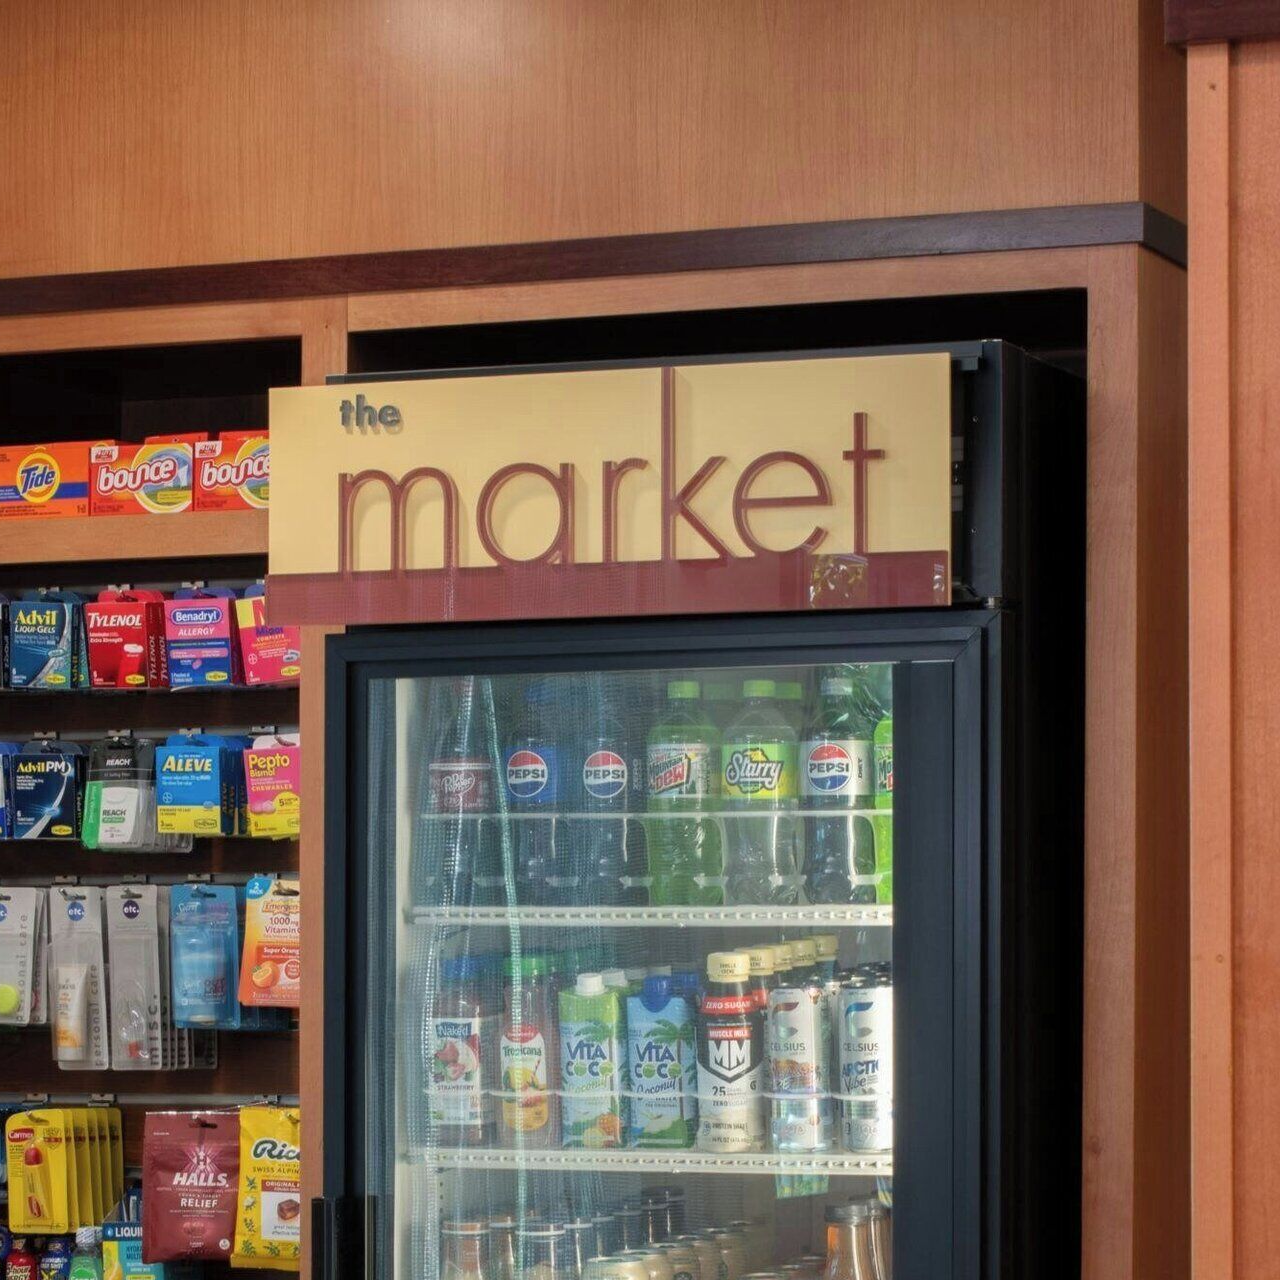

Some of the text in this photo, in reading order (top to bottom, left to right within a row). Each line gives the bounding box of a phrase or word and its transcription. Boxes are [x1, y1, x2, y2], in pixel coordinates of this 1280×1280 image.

[339, 394, 401, 428] the
[99, 459, 176, 491] bounce
[337, 366, 886, 573] market
[20, 464, 56, 496] Tide
[16, 609, 57, 625] Advil
[88, 612, 142, 628] TYLENOL
[176, 610, 217, 622] Benadryl
[178, 627, 215, 636] ALLERGY
[159, 635, 168, 681] TYLENOL
[17, 761, 66, 773] Advil PM
[162, 755, 212, 772] ALEVE
[248, 754, 290, 769] Pepto
[809, 762, 850, 773] PEPSI
[250, 769, 275, 778] Bismol
[508, 768, 545, 780] PEPSI
[585, 768, 625, 780] PEPSI
[726, 753, 783, 789] Starry
[102, 809, 126, 817] REACH
[255, 882, 260, 890] 2
[68, 907, 85, 916] etc.
[123, 905, 139, 913] etc.
[270, 917, 290, 926] 1000
[265, 926, 296, 934] Vitamin
[264, 947, 279, 955] Super
[90, 964, 99, 994] care
[706, 1000, 751, 1009] ZERO SUGAR
[439, 1024, 469, 1036] Naked
[710, 1029, 749, 1038] MUSCLE MILK
[503, 1046, 542, 1056] Tropicana
[567, 1040, 607, 1060] VITA
[635, 1041, 675, 1061] VITA
[843, 1042, 879, 1051] CELSIUS
[566, 1060, 613, 1077] COCO
[634, 1062, 682, 1078] COCO
[712, 1085, 726, 1096] 25
[180, 1199, 218, 1208] RELIEF
